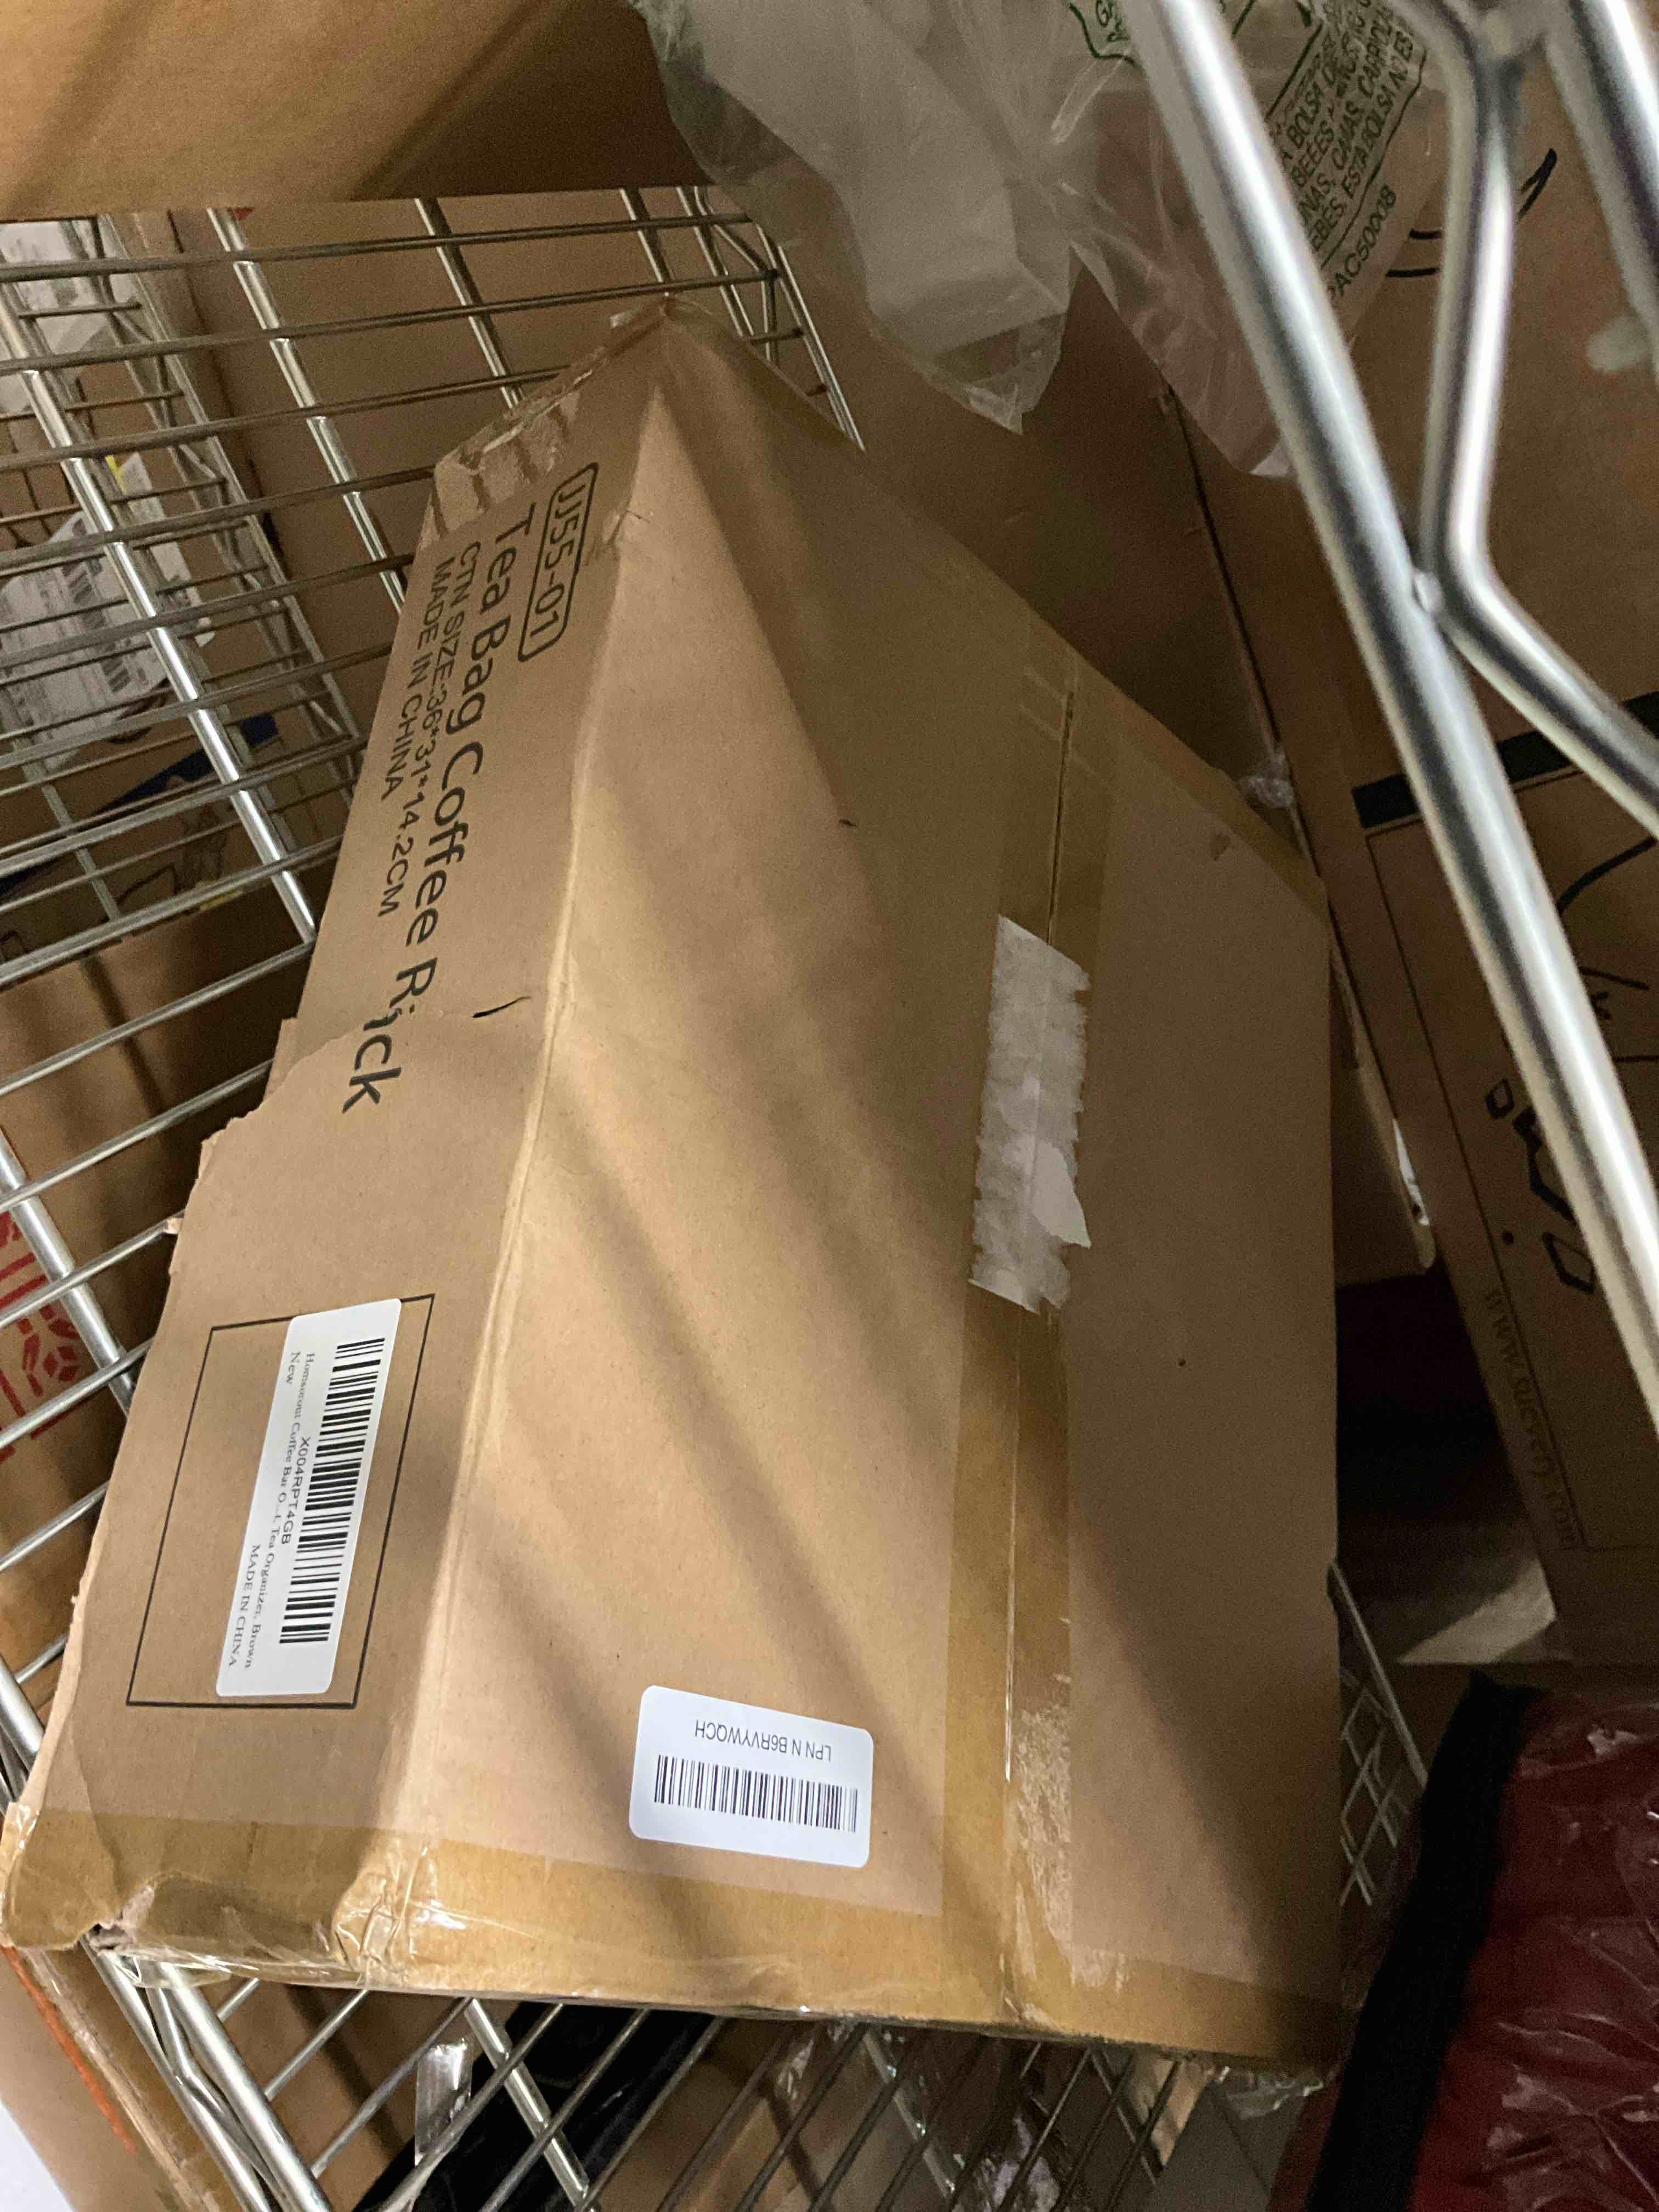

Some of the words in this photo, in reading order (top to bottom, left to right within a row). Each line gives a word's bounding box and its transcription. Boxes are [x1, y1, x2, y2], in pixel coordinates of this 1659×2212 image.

[1288, 82, 1323, 149] BOLSA
[450, 540, 481, 608] CTN
[480, 501, 535, 615] Tea
[417, 556, 455, 650] MADE
[407, 652, 433, 689] IN
[446, 614, 511, 735] Bag
[381, 693, 422, 801] CHINA
[406, 741, 483, 947] Coffee
[285, 1351, 302, 1385] New
[285, 1421, 301, 1463] Coffee
[280, 1466, 292, 1488] Bar
[281, 1436, 311, 1545] X004RPT4GB
[268, 1525, 282, 1549] Tea
[244, 1544, 262, 1591] MADE
[240, 1593, 251, 1612] IN
[228, 1615, 246, 1667] CHINA
[244, 1623, 262, 1668] Brown
[695, 1719, 788, 1753] B6RVYWQCH
[791, 1738, 802, 1757] N
[805, 1740, 832, 1763] LPN
